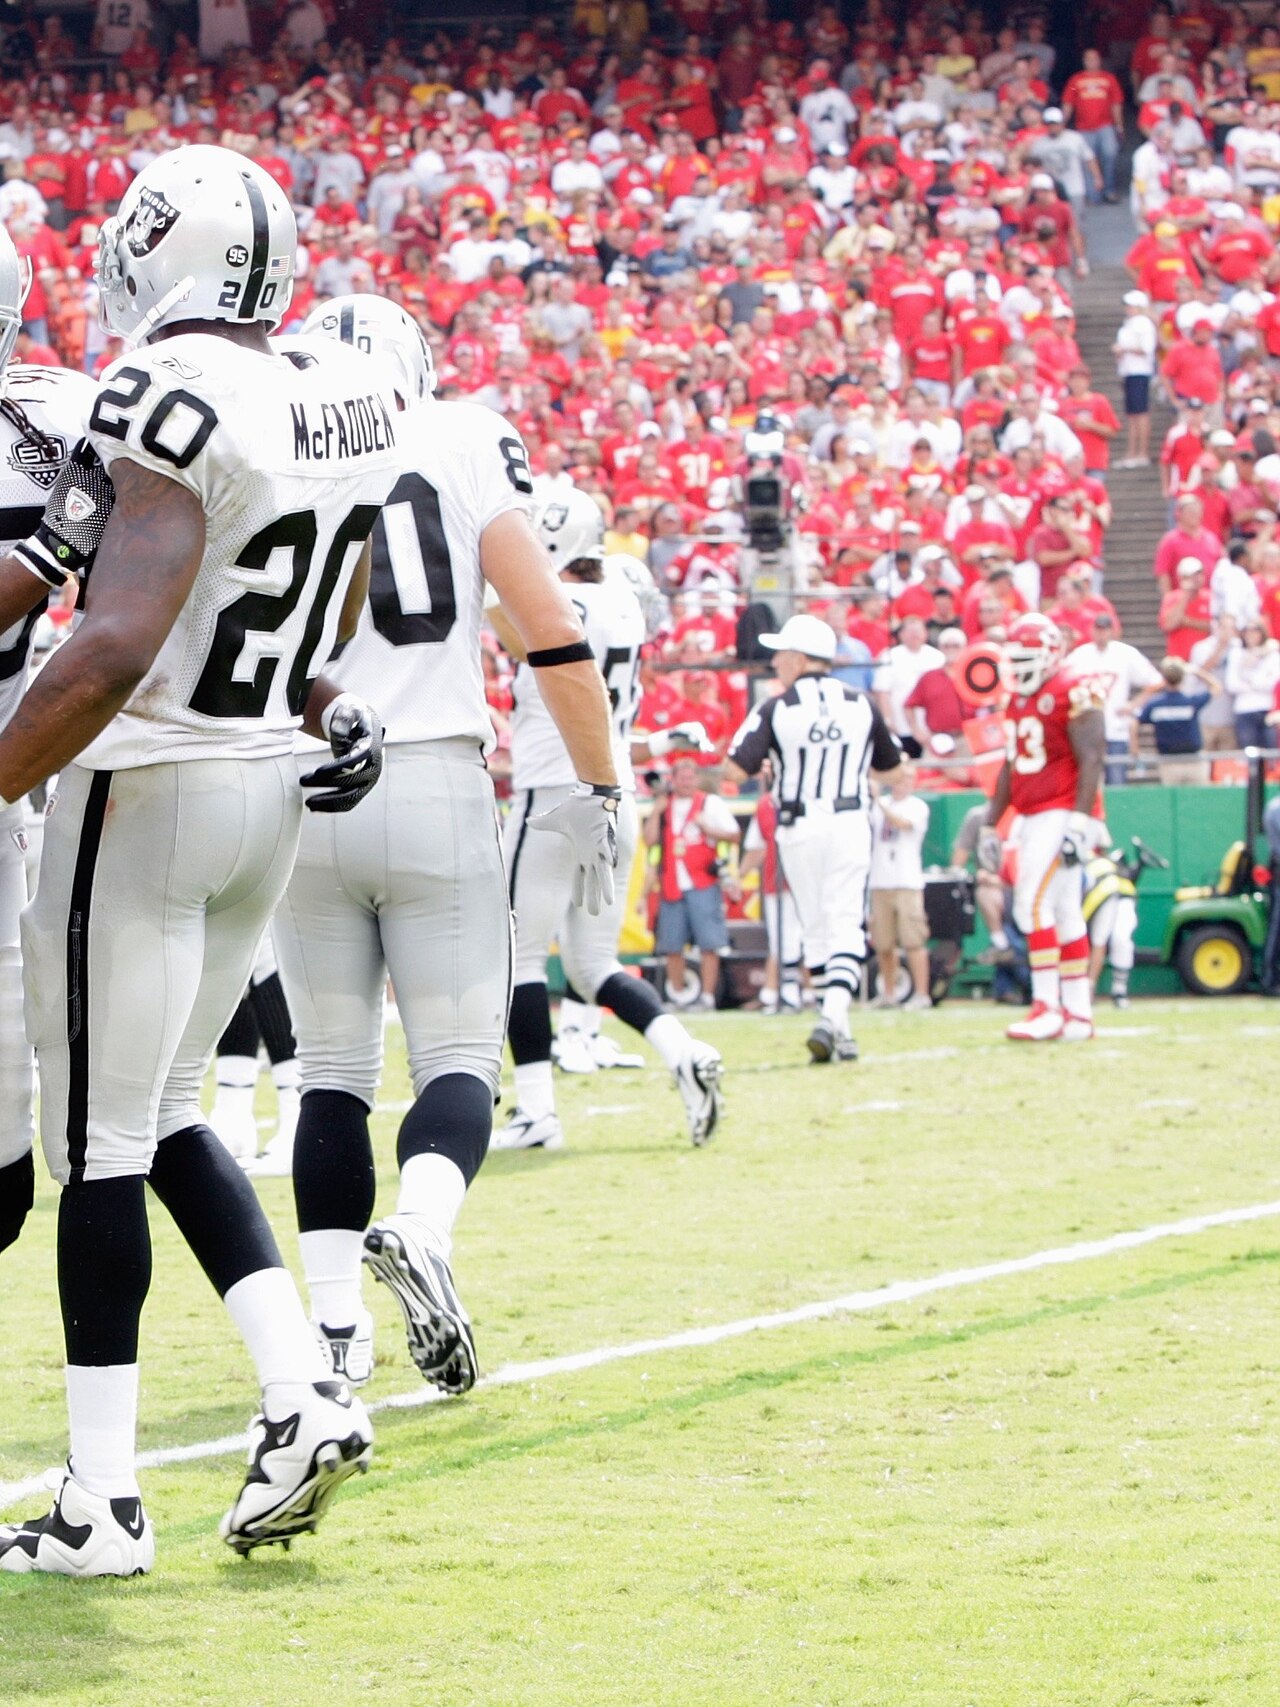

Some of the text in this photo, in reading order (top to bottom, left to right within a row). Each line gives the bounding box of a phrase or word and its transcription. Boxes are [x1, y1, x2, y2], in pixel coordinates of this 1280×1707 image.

[141, 187, 176, 218] RAIDERS
[228, 248, 248, 264] 95
[218, 280, 277, 309] 20
[89, 366, 219, 468] 20
[289, 392, 396, 461] McFADDEN
[188, 503, 383, 718] 20
[808, 720, 842, 744] 66
